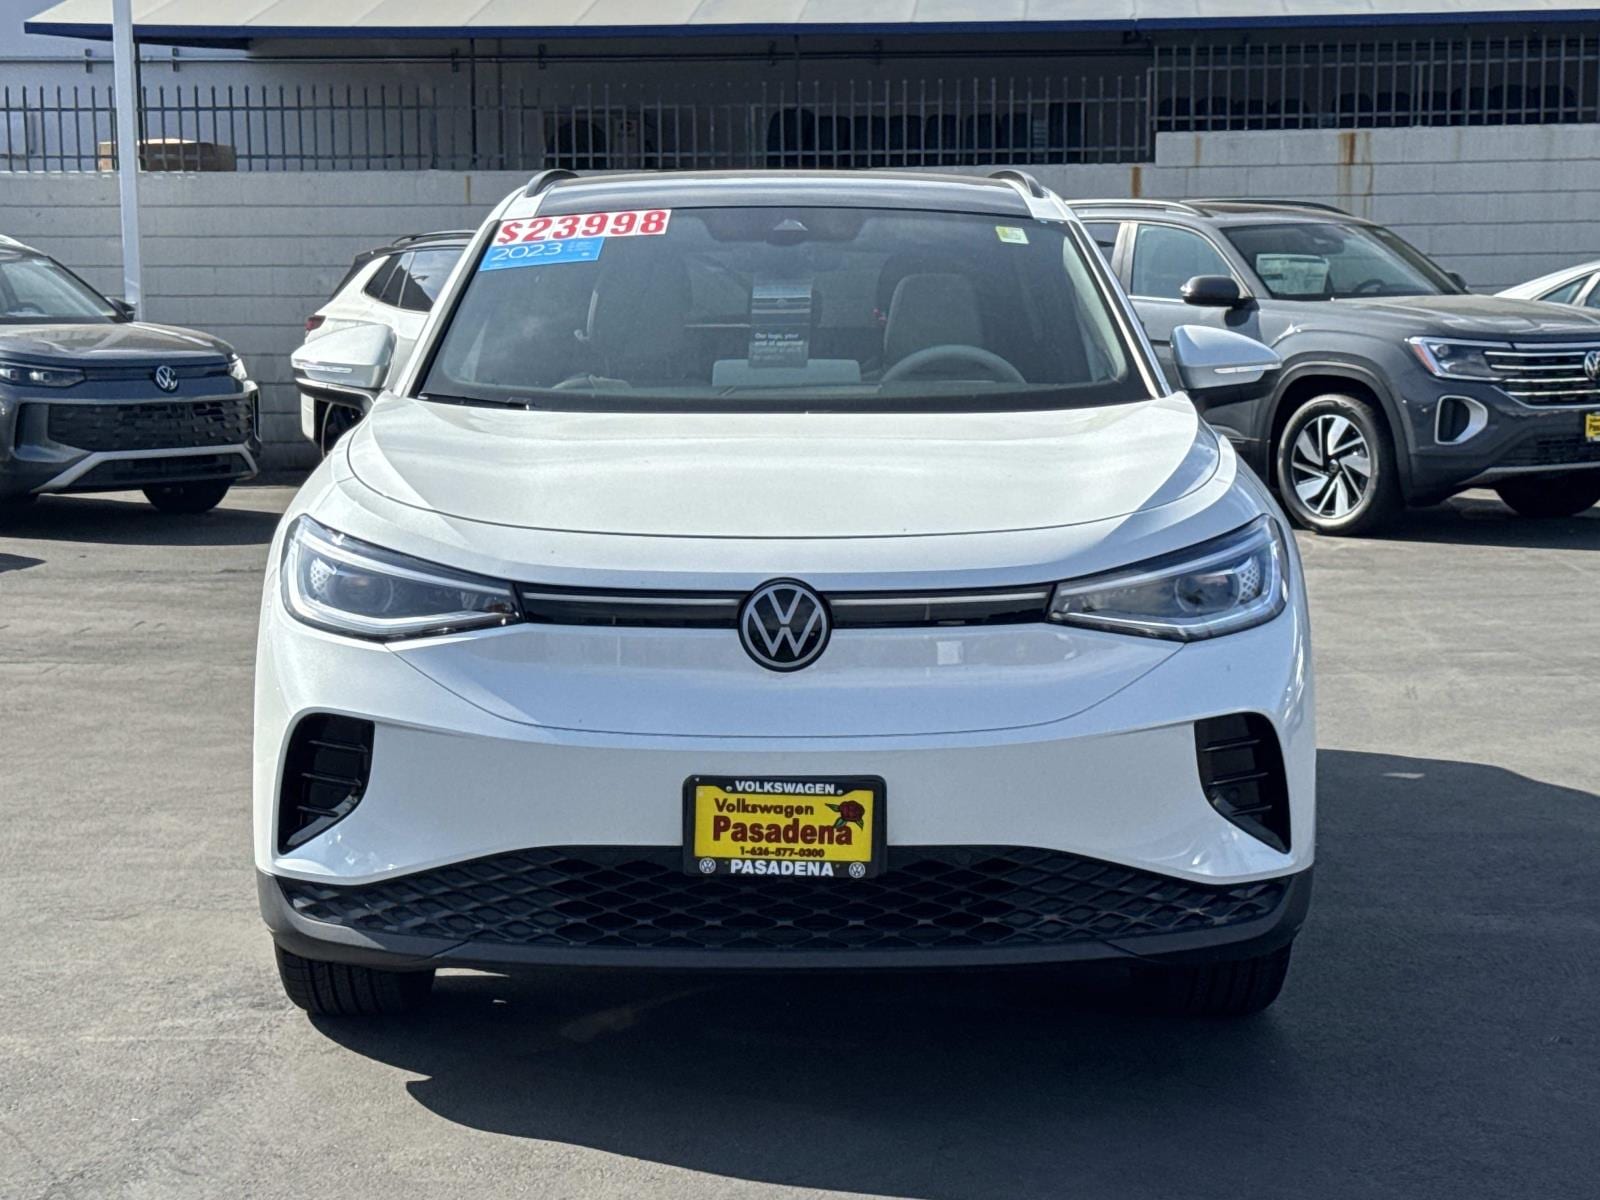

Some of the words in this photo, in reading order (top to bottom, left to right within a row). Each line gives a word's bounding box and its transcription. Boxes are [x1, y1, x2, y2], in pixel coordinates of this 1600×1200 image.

[497, 210, 667, 244] $23998
[491, 242, 562, 261] 2023
[743, 583, 827, 667] VW
[735, 780, 835, 795] VOLKSWAGEN
[714, 798, 815, 818] Volkswagen
[713, 815, 853, 846] Pasadena
[730, 859, 834, 877] PASADENA
